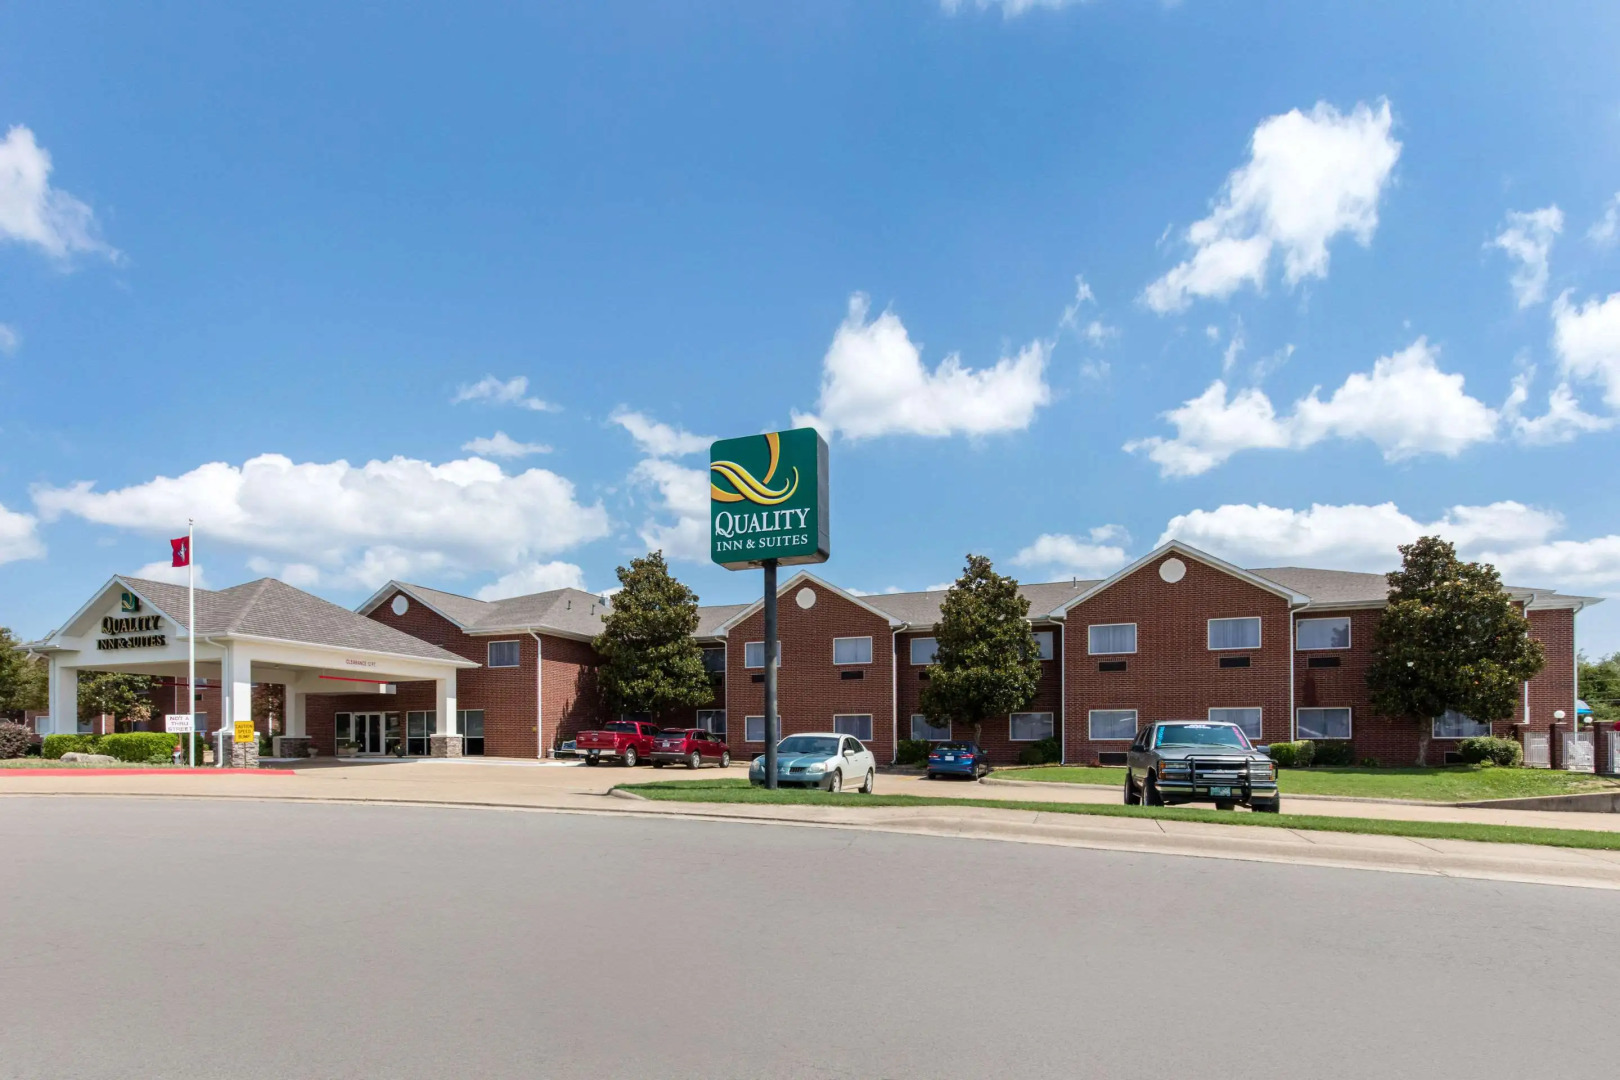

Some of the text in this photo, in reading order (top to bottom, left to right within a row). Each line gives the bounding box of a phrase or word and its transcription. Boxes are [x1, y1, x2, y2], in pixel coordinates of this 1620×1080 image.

[715, 508, 810, 538] QUALITY
[716, 534, 808, 552] INN & SUITES
[101, 615, 161, 635] QUALITY
[97, 638, 119, 650] INN
[128, 635, 166, 648] SUITES
